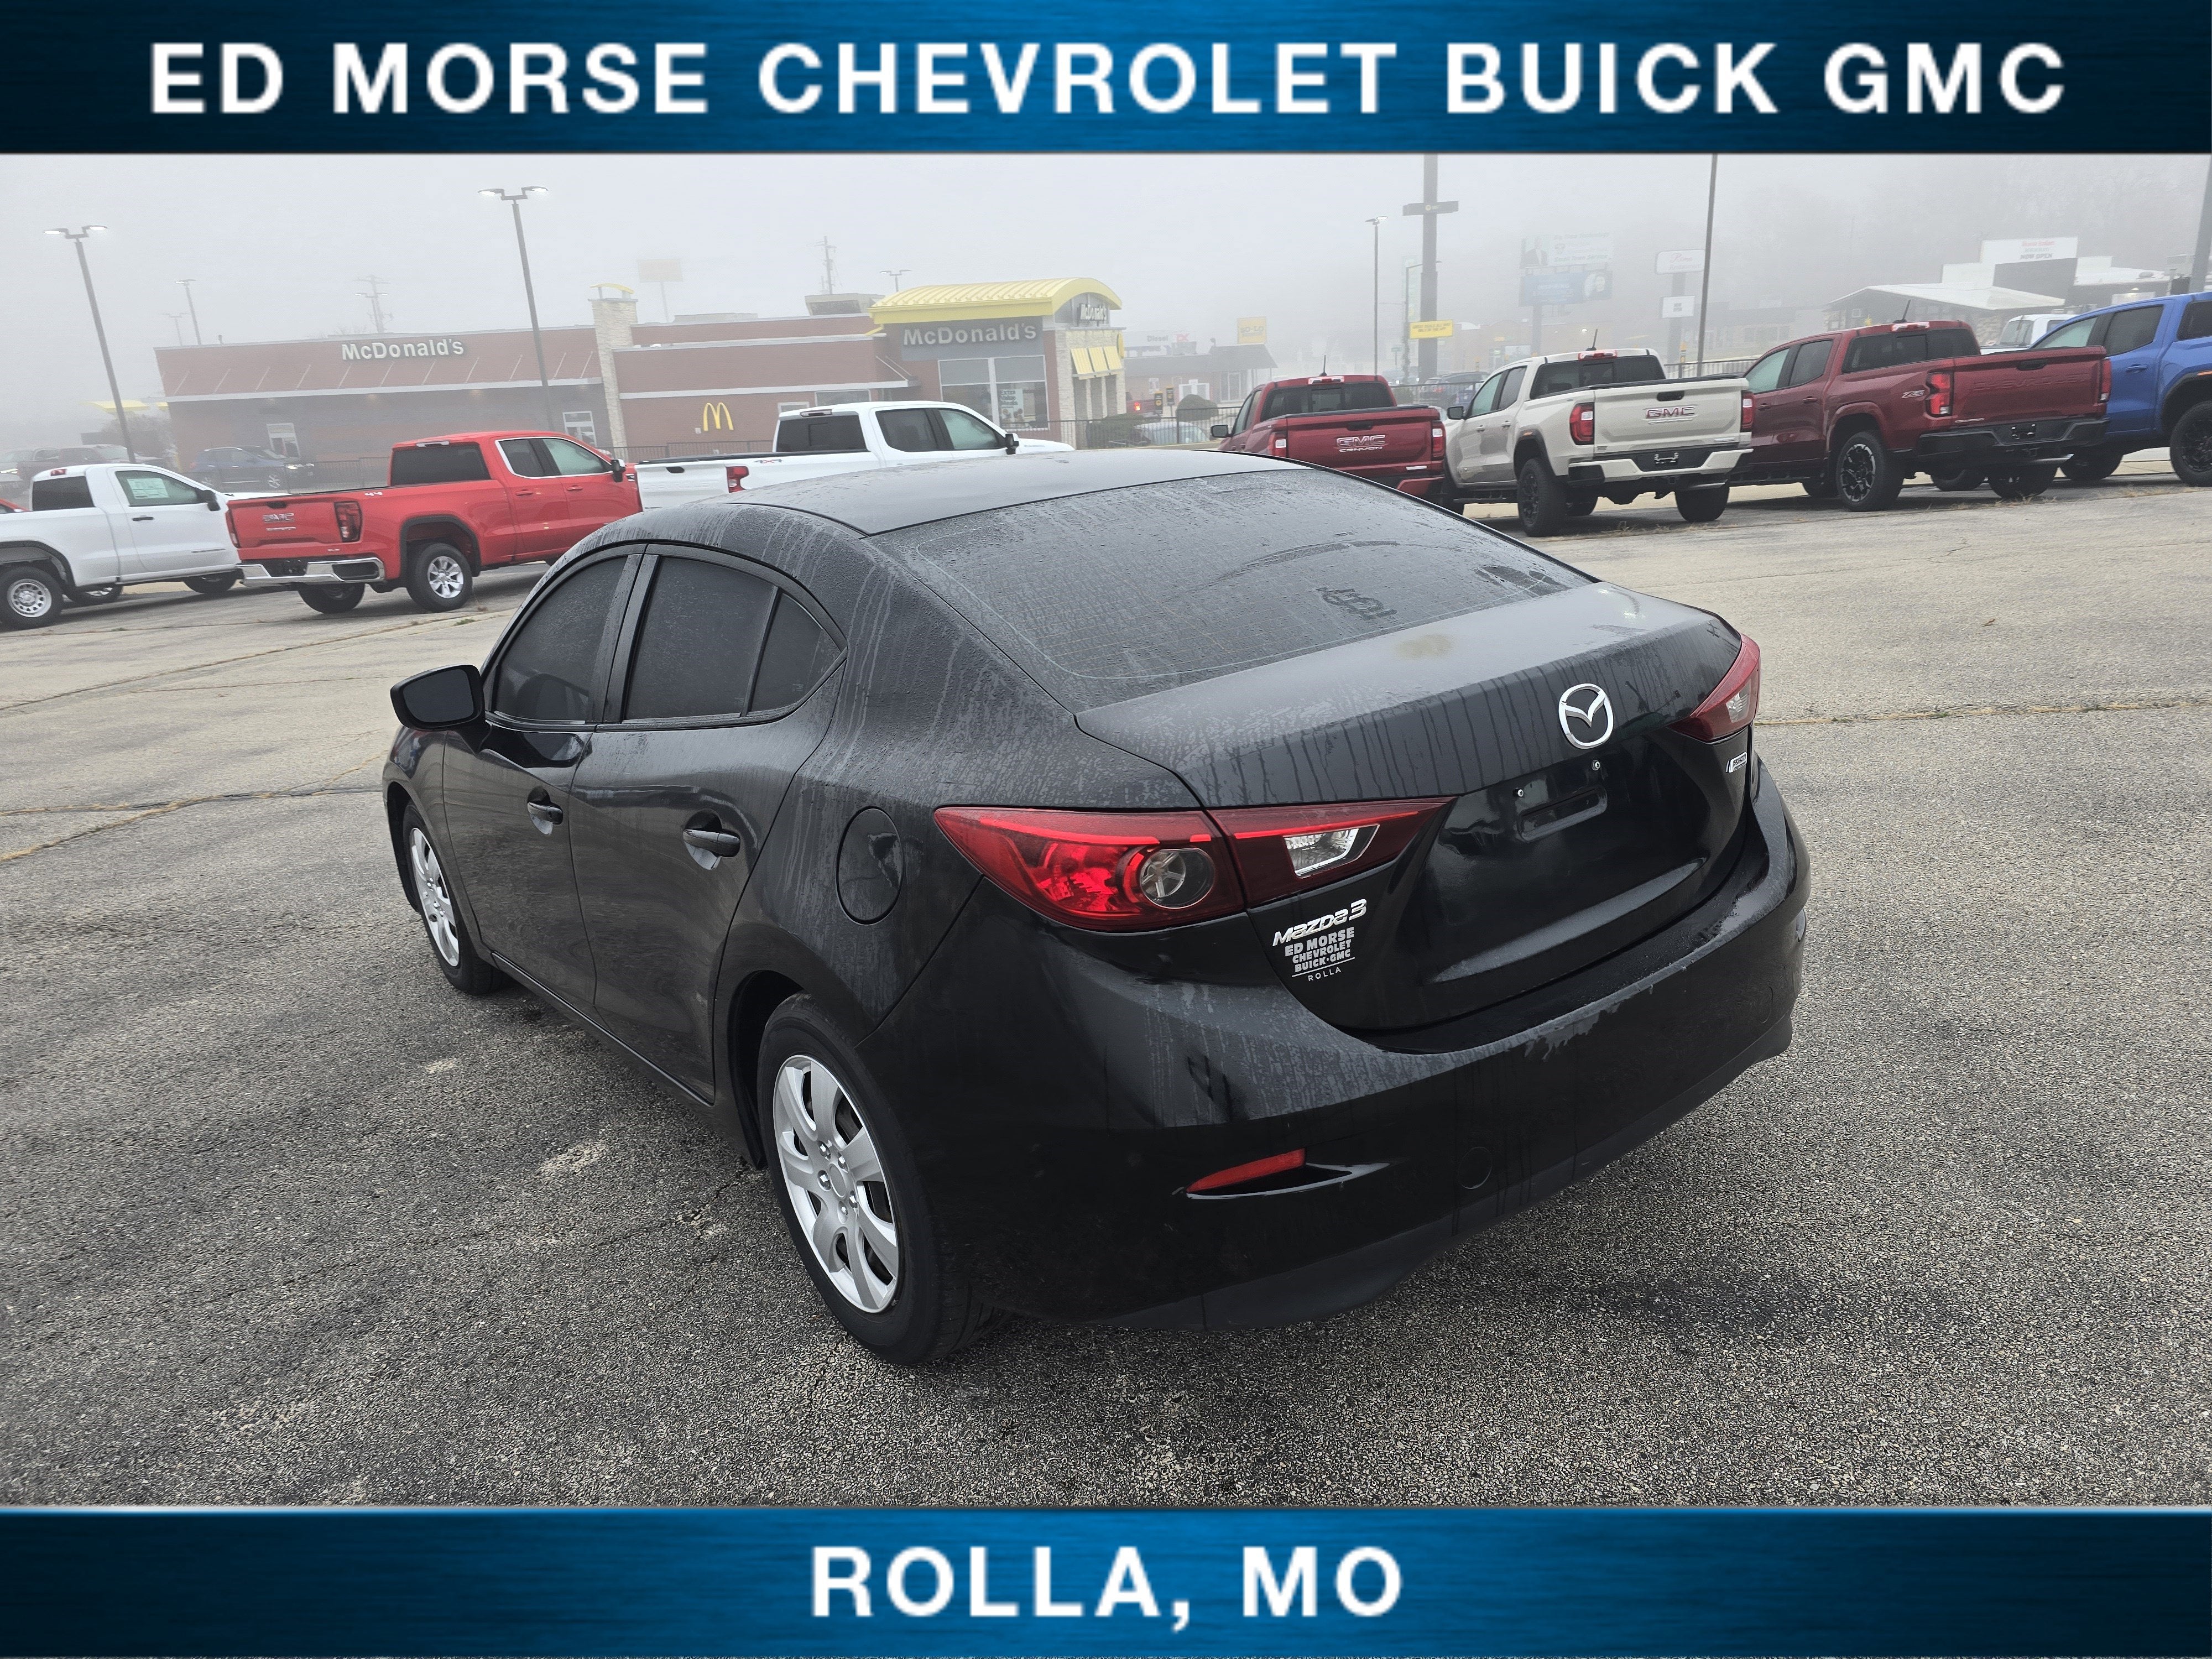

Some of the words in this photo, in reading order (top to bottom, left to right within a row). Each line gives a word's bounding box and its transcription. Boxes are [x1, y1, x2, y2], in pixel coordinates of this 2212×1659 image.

[903, 322, 1037, 346] McDonald's
[341, 338, 465, 360] McDonald's
[1646, 405, 1695, 419] GMC
[1337, 435, 1385, 447] GMC
[1285, 942, 1304, 957] ED
[1306, 926, 1355, 951] MORSE
[1292, 938, 1352, 964] CHEVROLET
[1308, 967, 1342, 982] ROLLA
